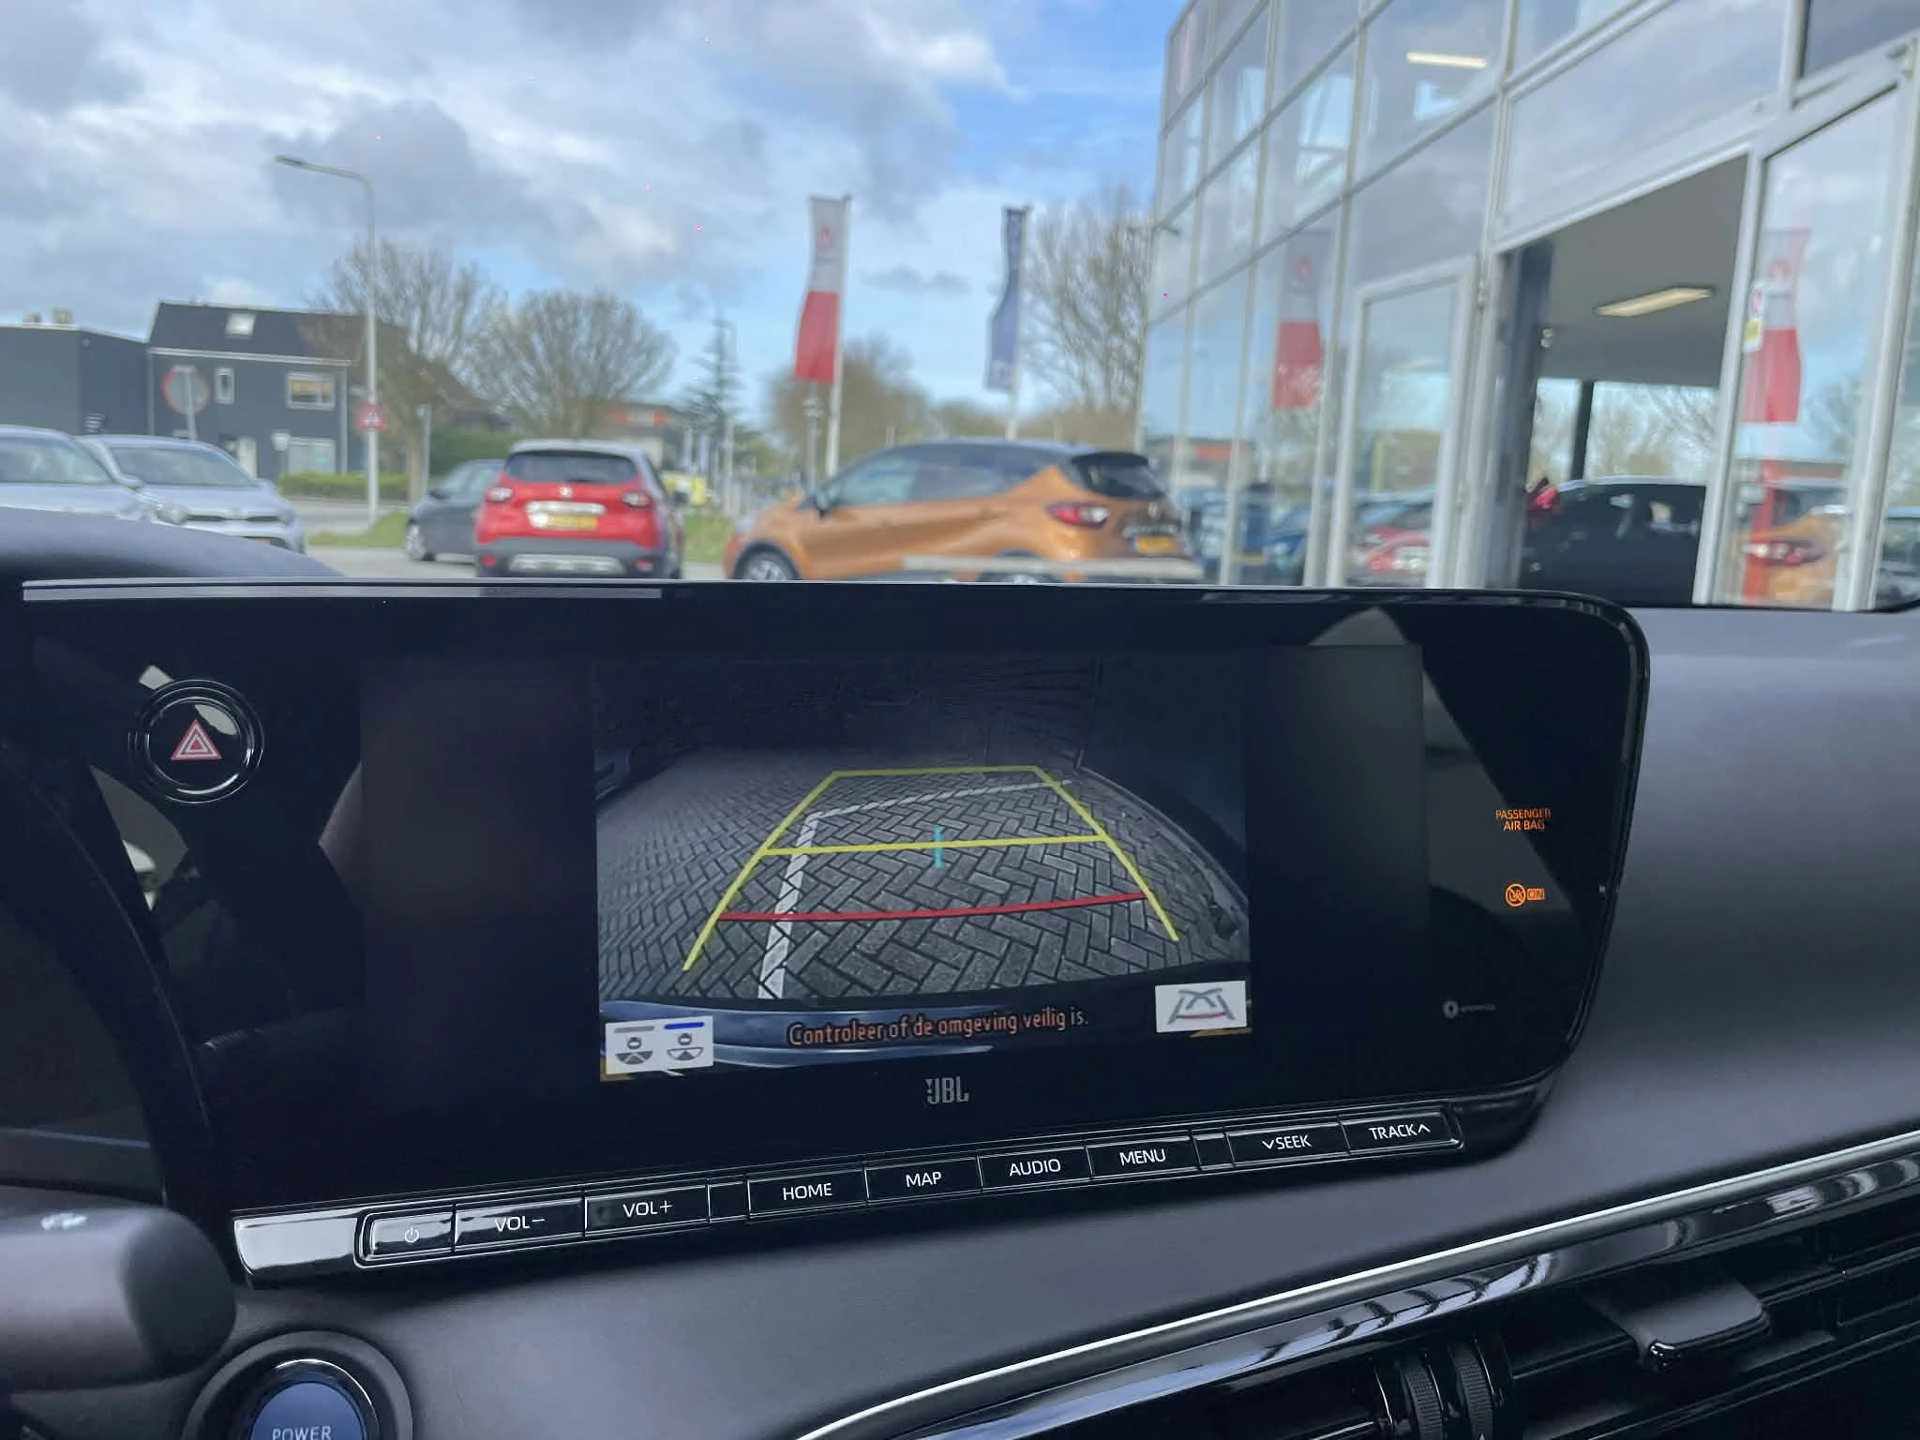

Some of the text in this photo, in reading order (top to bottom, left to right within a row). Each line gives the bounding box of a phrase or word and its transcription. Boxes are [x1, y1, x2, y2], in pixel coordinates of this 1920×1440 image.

[1496, 808, 1551, 820] PASSENGER
[1503, 819, 1545, 831] AIR BAG
[789, 1006, 1089, 1046] Controleer of de omgeving veilig is.
[926, 1077, 970, 1105] JBL
[1119, 1147, 1167, 1166] MENU
[1008, 1157, 1062, 1178] AUDIO
[904, 1170, 943, 1189] MAP
[782, 1182, 833, 1202] HOME
[622, 1199, 674, 1219] VOL+
[272, 1425, 332, 1440] POWER
